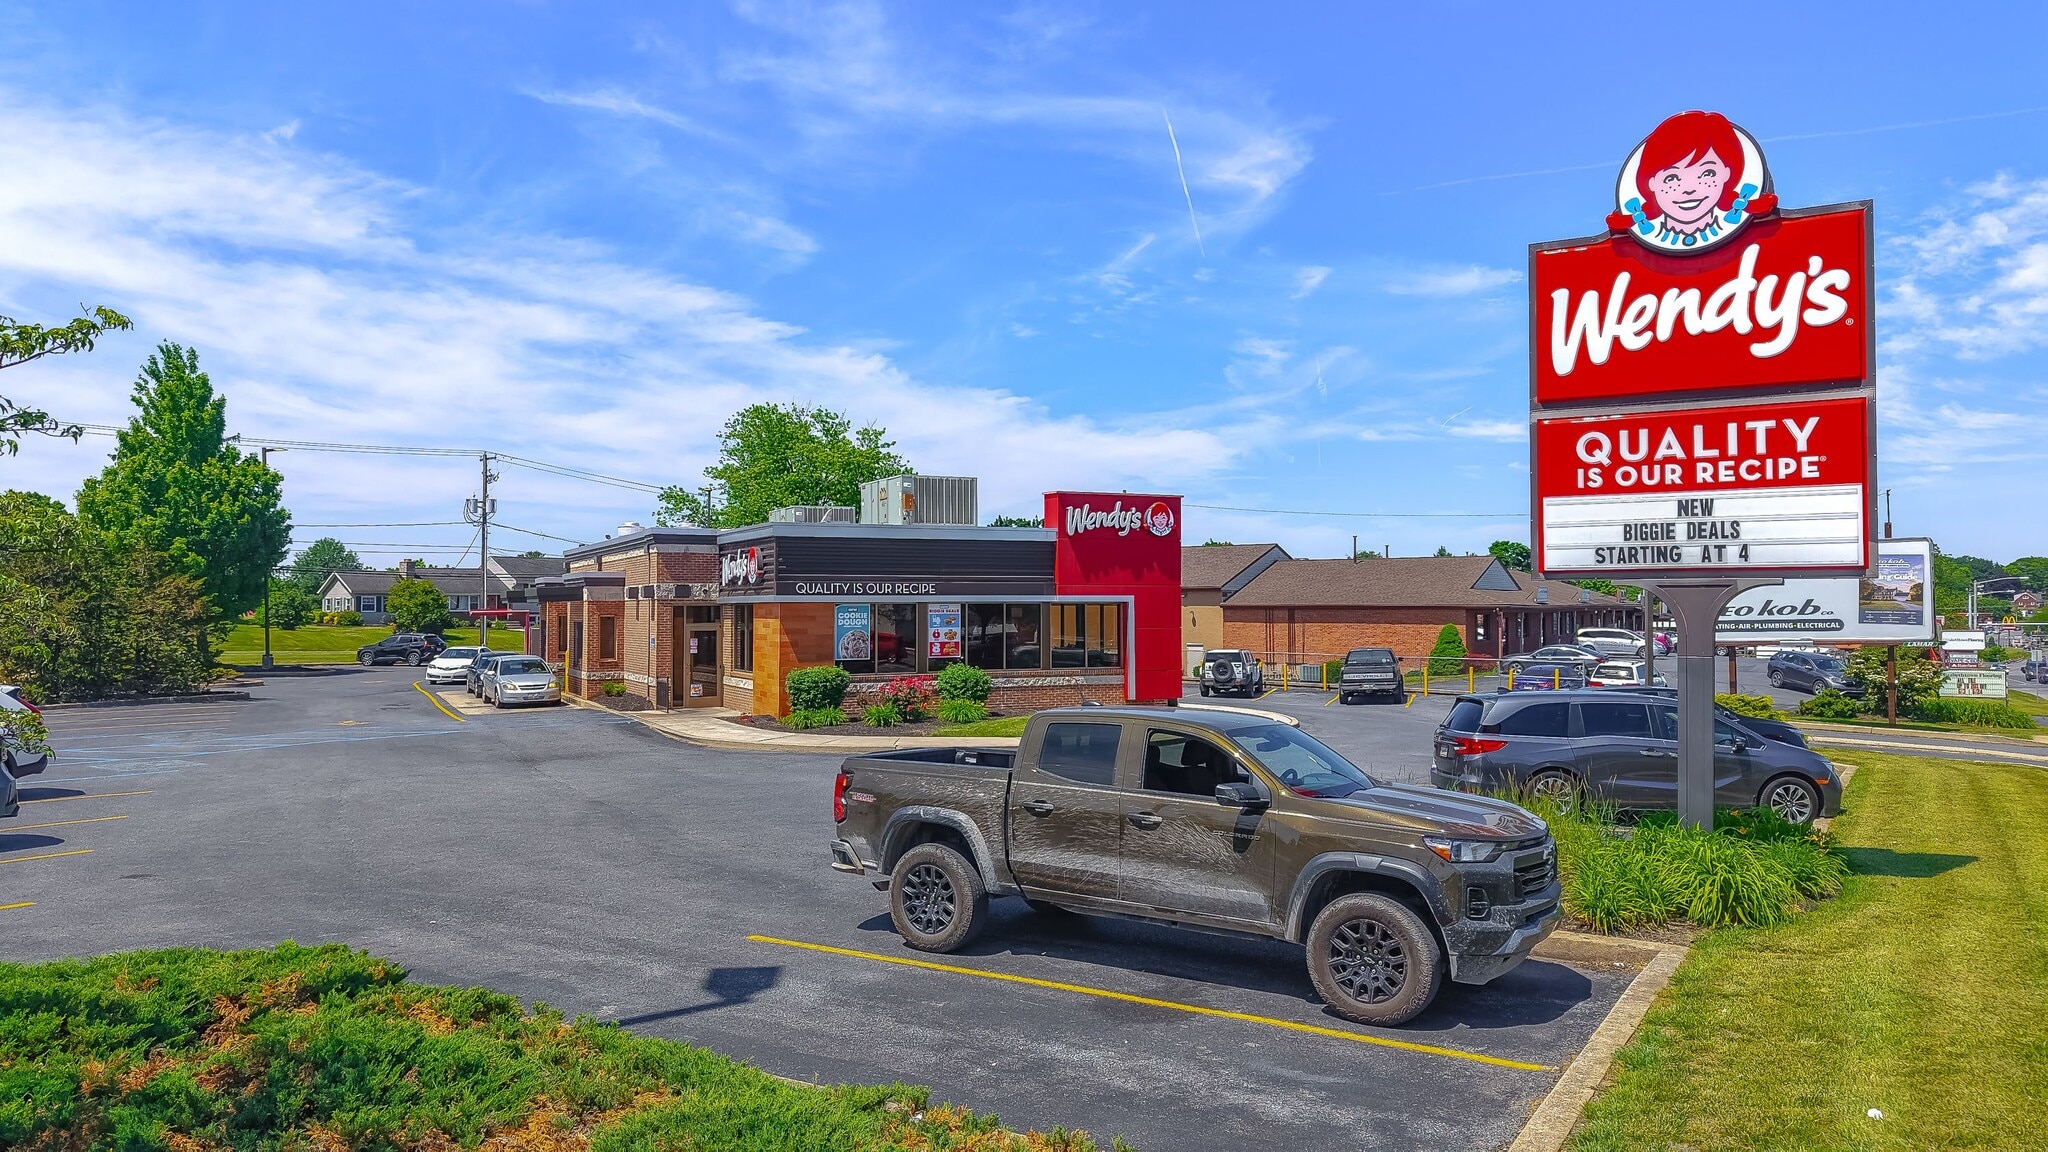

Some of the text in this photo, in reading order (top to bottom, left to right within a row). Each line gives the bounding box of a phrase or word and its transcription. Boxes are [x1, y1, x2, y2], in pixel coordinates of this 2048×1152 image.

[1551, 244, 1850, 376] Wendy's
[1576, 417, 1821, 467] QUALITY
[1577, 455, 1821, 489] IS OUR RECIPE
[1066, 501, 1142, 537] Wendy's
[1677, 498, 1715, 518] NEW
[1623, 520, 1741, 542] BIGGIE DEALS
[1595, 543, 1750, 565] STARTING AT 4
[721, 548, 747, 587] Wendy's
[1894, 572, 1918, 581] Guide
[796, 582, 936, 594] QUALITY IS OUR RECIPE
[1757, 599, 1821, 616] kob
